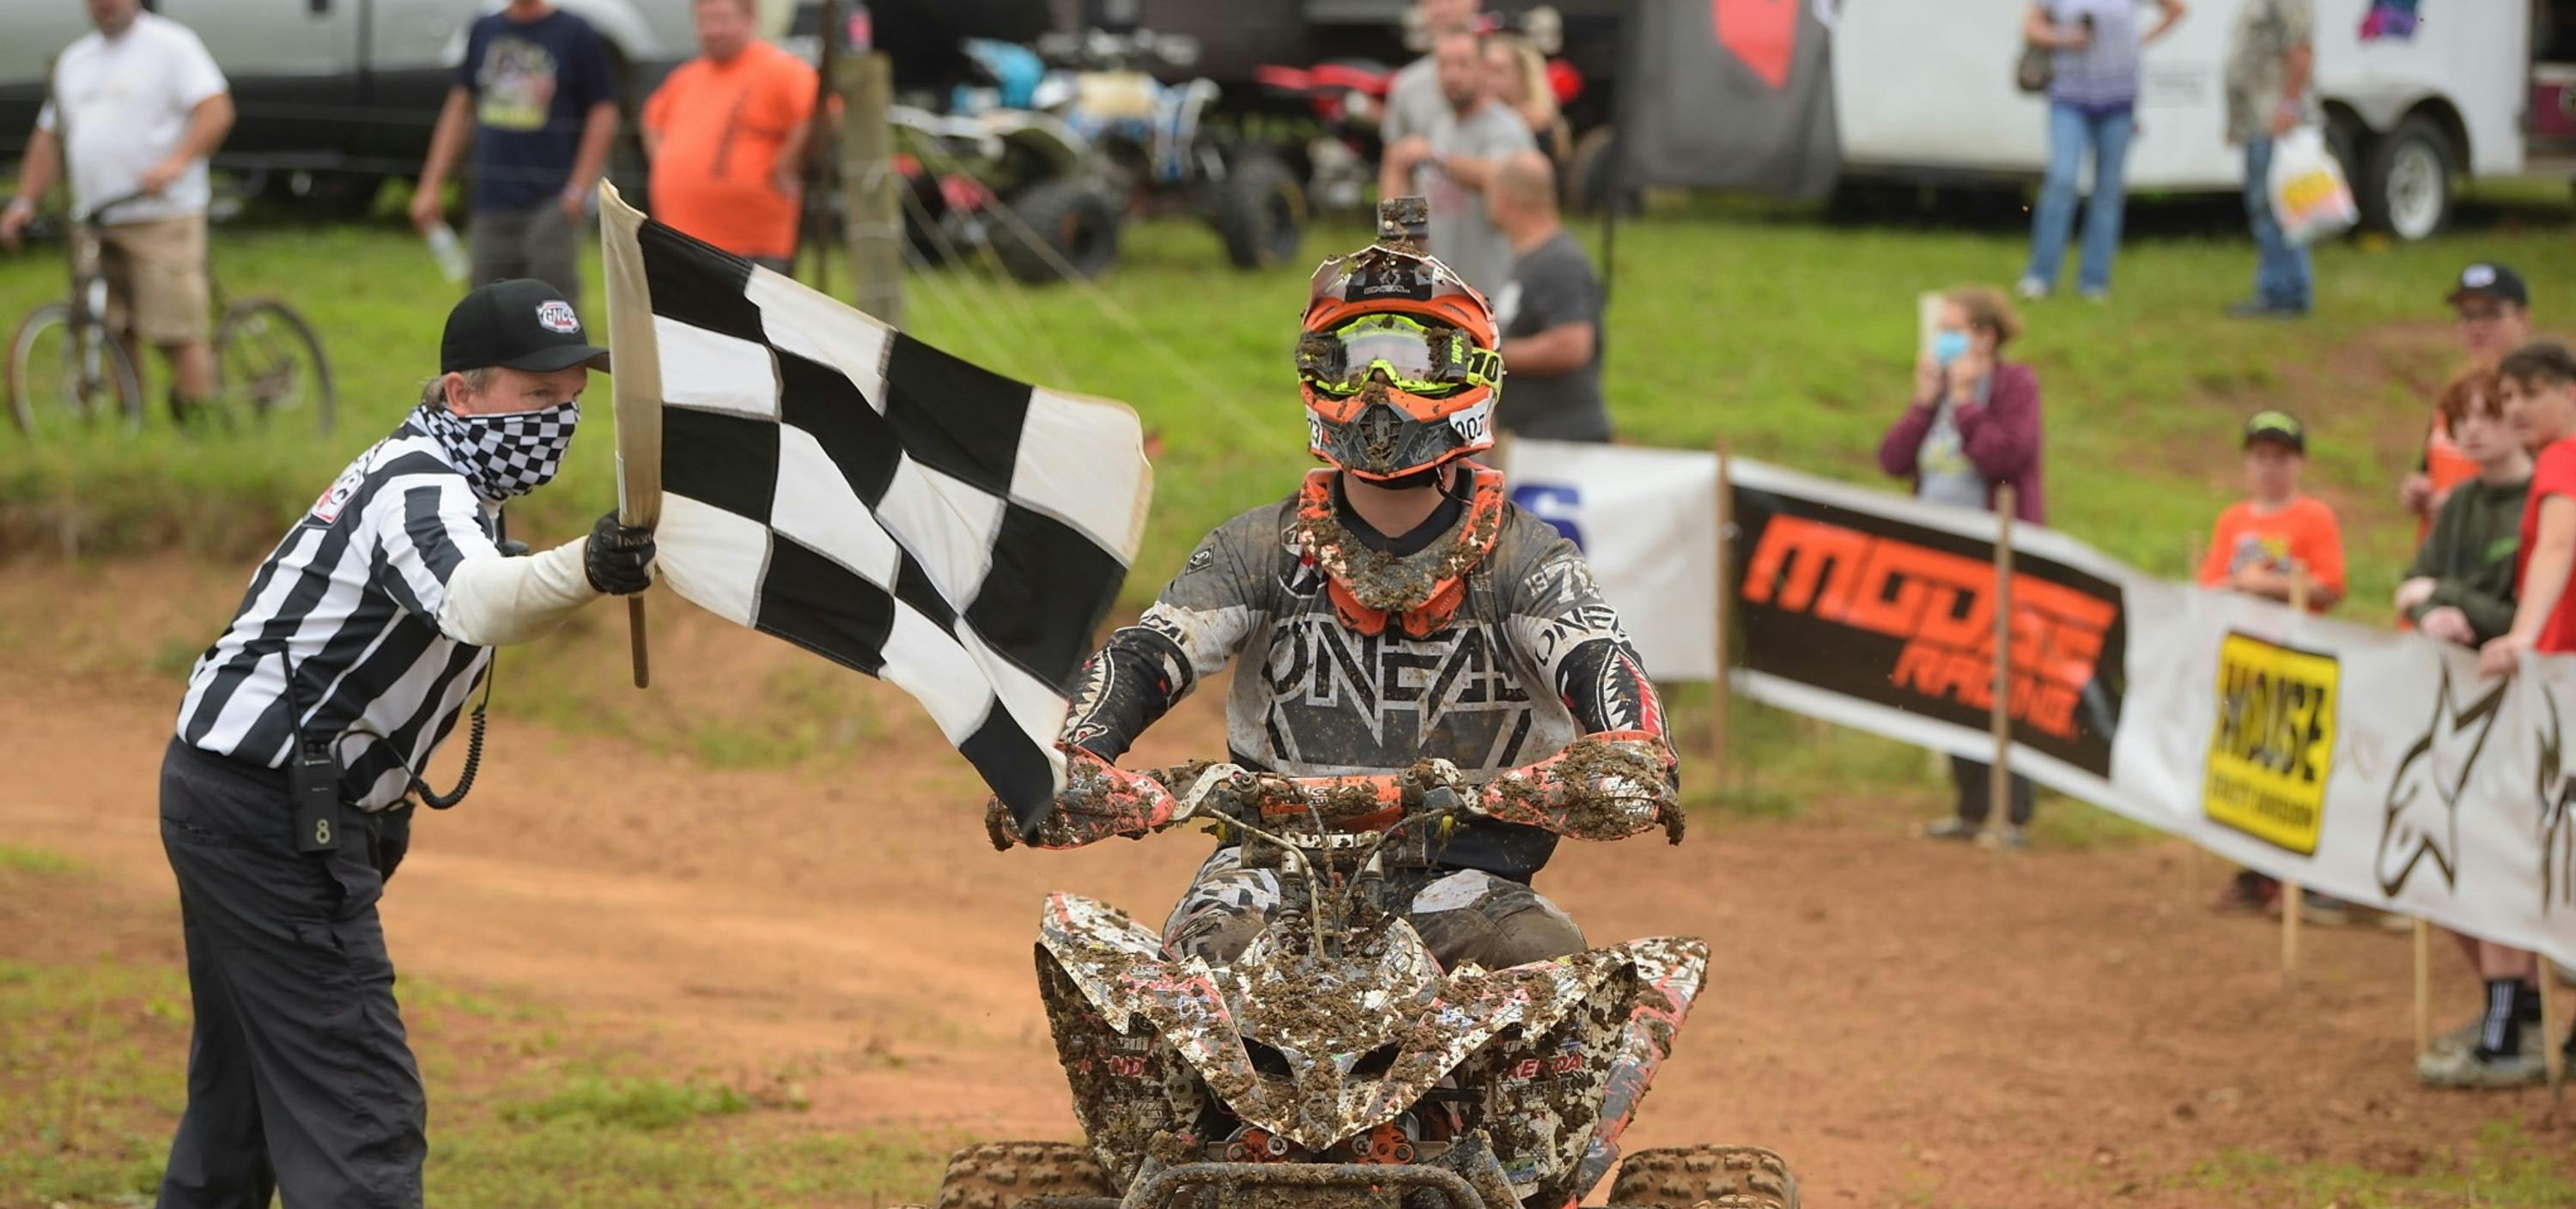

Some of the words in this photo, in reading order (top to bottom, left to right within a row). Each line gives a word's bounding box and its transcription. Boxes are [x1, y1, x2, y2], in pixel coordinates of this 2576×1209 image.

[542, 307, 574, 325] GNCC
[1451, 335, 1463, 364] 100%
[1741, 513, 2117, 689] MOOSE
[1891, 640, 2078, 739] RACING
[316, 818, 330, 844] 8
